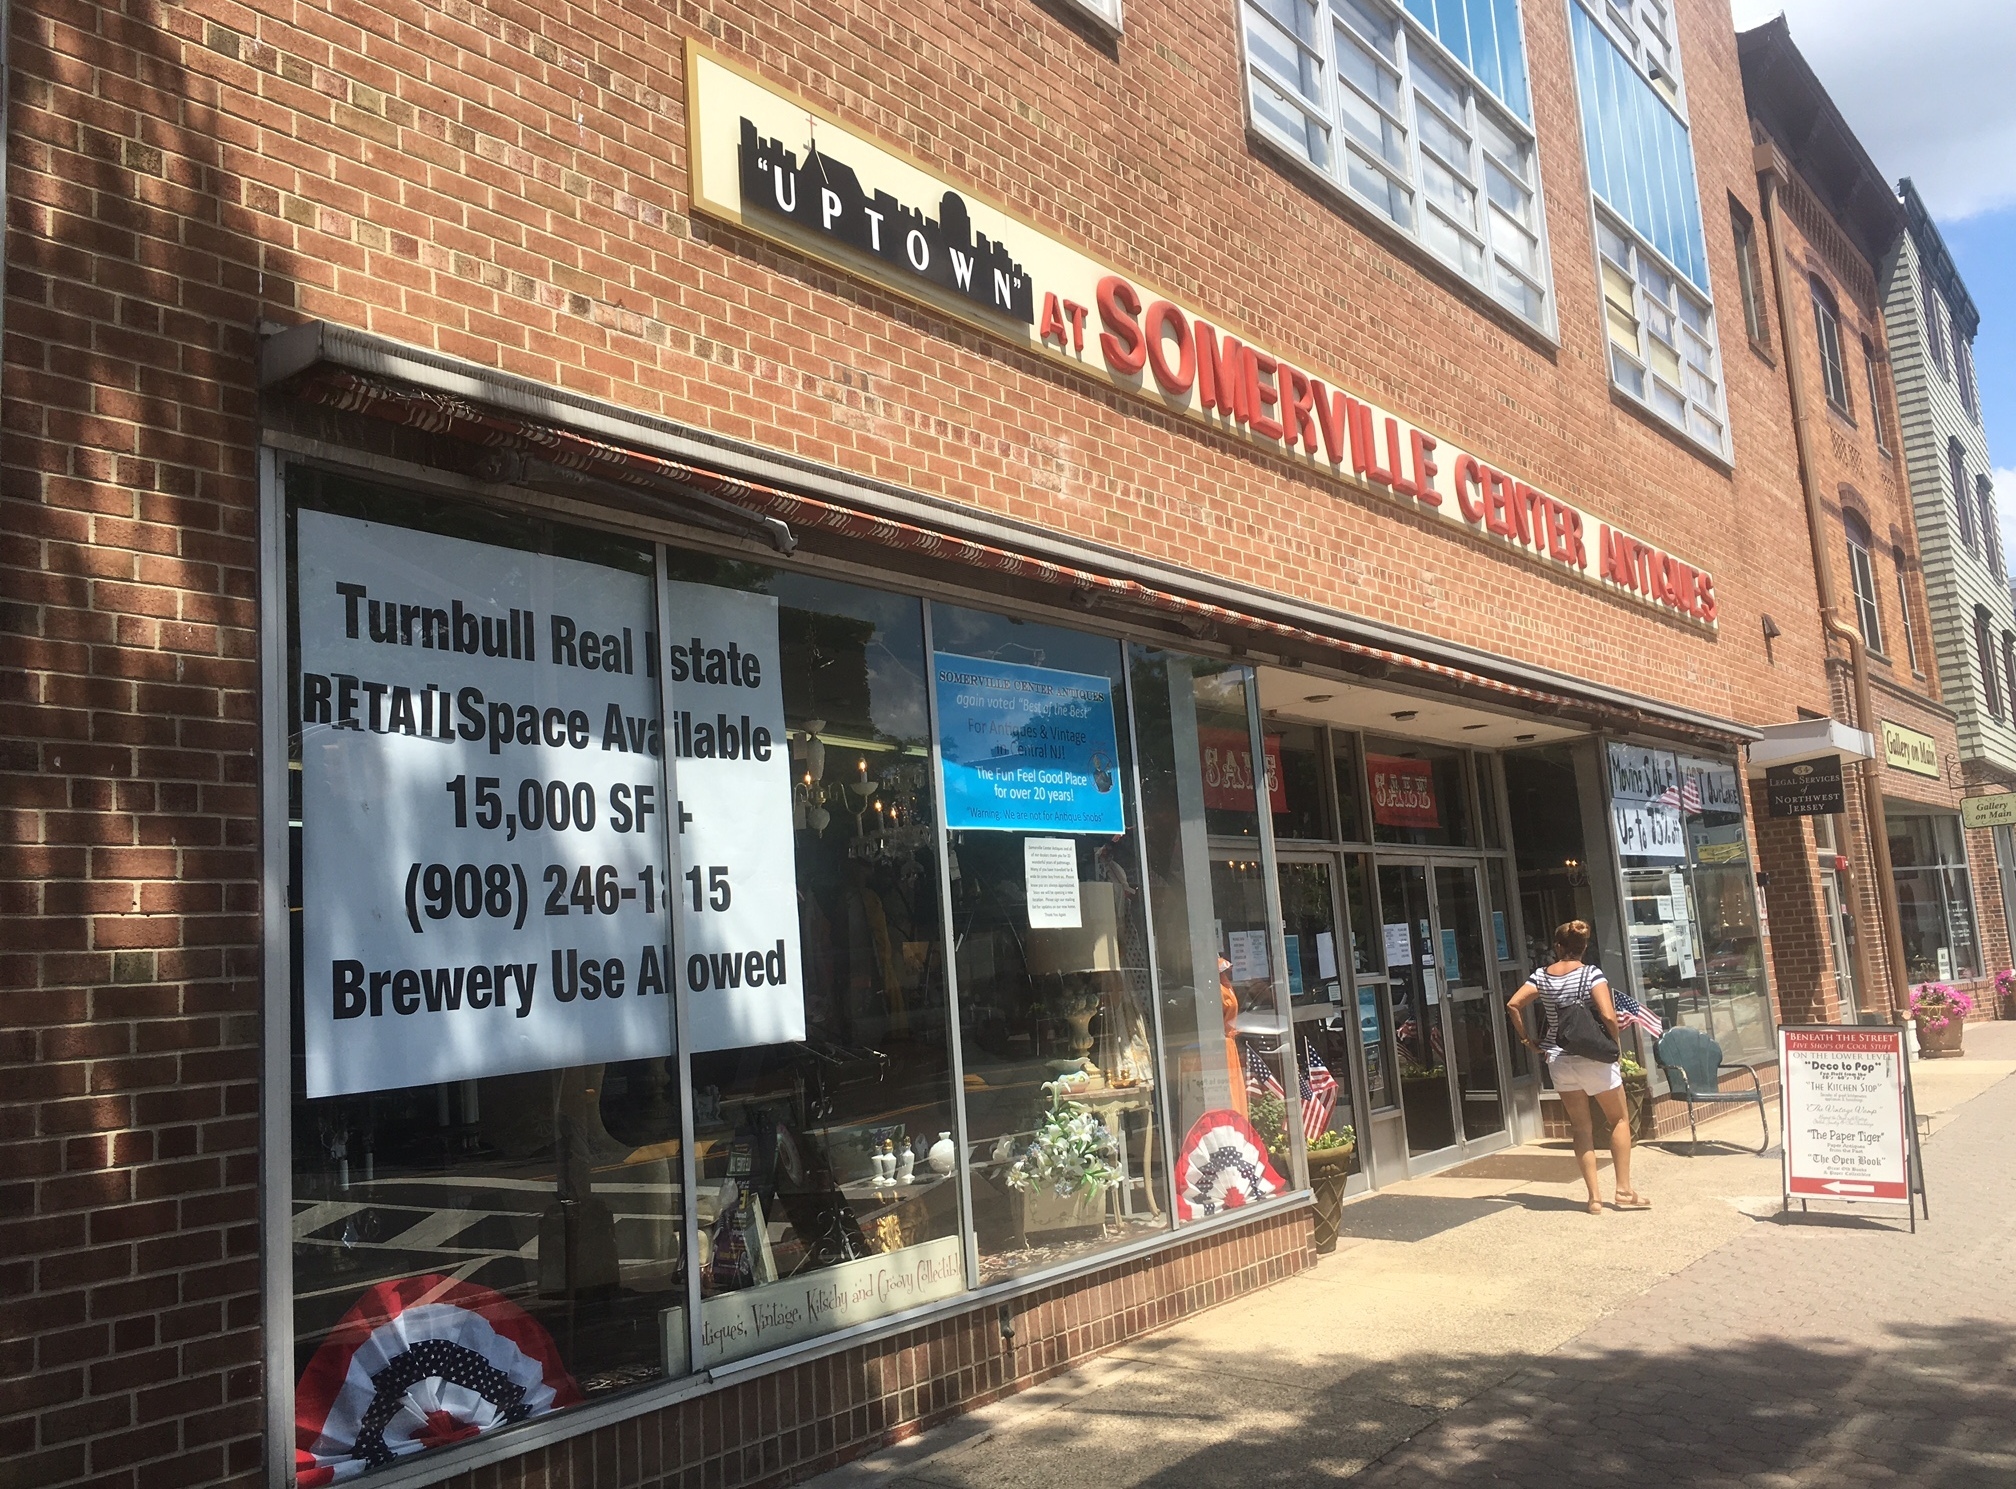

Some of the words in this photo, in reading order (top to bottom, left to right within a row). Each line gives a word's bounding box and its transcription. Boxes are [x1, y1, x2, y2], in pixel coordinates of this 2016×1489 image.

[757, 157, 1021, 310] "UPTOWN"
[1040, 291, 1088, 353] AT
[1096, 276, 1442, 507] SOMERVILLE
[1455, 453, 1588, 570] CENTER
[1600, 524, 1718, 623] ANTIQUES
[336, 581, 535, 662] Turnbull
[551, 614, 633, 675] Real
[940, 670, 1010, 690] SOMERVILLE
[1014, 681, 1053, 694] CENTER
[1057, 686, 1104, 701] ANTIQUES
[956, 694, 984, 708] again
[988, 697, 1015, 710] voted
[1018, 698, 1041, 712] "Best
[1043, 702, 1052, 716] of
[1054, 702, 1068, 714] the
[1070, 705, 1092, 718] Best"
[304, 673, 455, 738] RETAIL
[457, 686, 590, 754] Space
[601, 703, 772, 763] Available
[968, 718, 986, 734] For
[990, 720, 1037, 740] Antiques
[1040, 725, 1048, 739] &
[1050, 727, 1086, 744] Vintage
[996, 740, 1007, 756] in
[1011, 740, 1047, 758] Central
[1049, 744, 1065, 759] NJ!
[1886, 730, 1910, 765] Gallery
[1911, 744, 1920, 761] on
[1919, 741, 1936, 766] Main
[976, 766, 994, 780] The
[996, 768, 1014, 782] Fun
[1018, 769, 1036, 782] Feel
[1038, 770, 1064, 784] Good
[1066, 773, 1087, 786] Place
[1770, 778, 1798, 786] LEGAL
[1800, 775, 1840, 784] SERVICES
[994, 784, 1006, 798] for
[1010, 788, 1031, 800] over
[1034, 786, 1046, 800] 20
[1048, 788, 1074, 804] years!
[1775, 793, 1840, 804] NORTHWEST
[1800, 784, 1809, 794] of
[446, 775, 595, 840] 15,000
[610, 784, 654, 834] SF
[966, 806, 1002, 820] "Warning:
[1004, 809, 1014, 820] We
[1016, 812, 1028, 820] are
[1030, 812, 1042, 820] not
[1043, 811, 1054, 820] for
[1055, 812, 1082, 823] Antique
[1083, 812, 1104, 822] Snobs"
[1787, 804, 1824, 815] JERSEY
[1976, 802, 2008, 812] Gallery
[1988, 810, 2012, 820] Main
[1616, 806, 1634, 850] Up
[405, 862, 528, 933] (908)
[332, 958, 538, 1020] Brewery
[551, 949, 624, 1002] Use
[637, 939, 787, 996] Alowed
[1786, 1032, 1833, 1041] "BENEATH
[1859, 1033, 1897, 1042] STREET"
[1805, 1061, 1839, 1070] "Deco
[1842, 1062, 1852, 1070] to
[1855, 1062, 1881, 1073] Pop"
[1828, 1082, 1857, 1092] KITCHEN
[1830, 1130, 1855, 1143] Paper
[1858, 1131, 1884, 1145] Tiger"
[1832, 1155, 1855, 1165] Open
[702, 1314, 748, 1353] tiques,
[806, 1284, 848, 1323] Kitschy
[852, 1273, 874, 1304] and
[878, 1269, 914, 1304] Groovy
